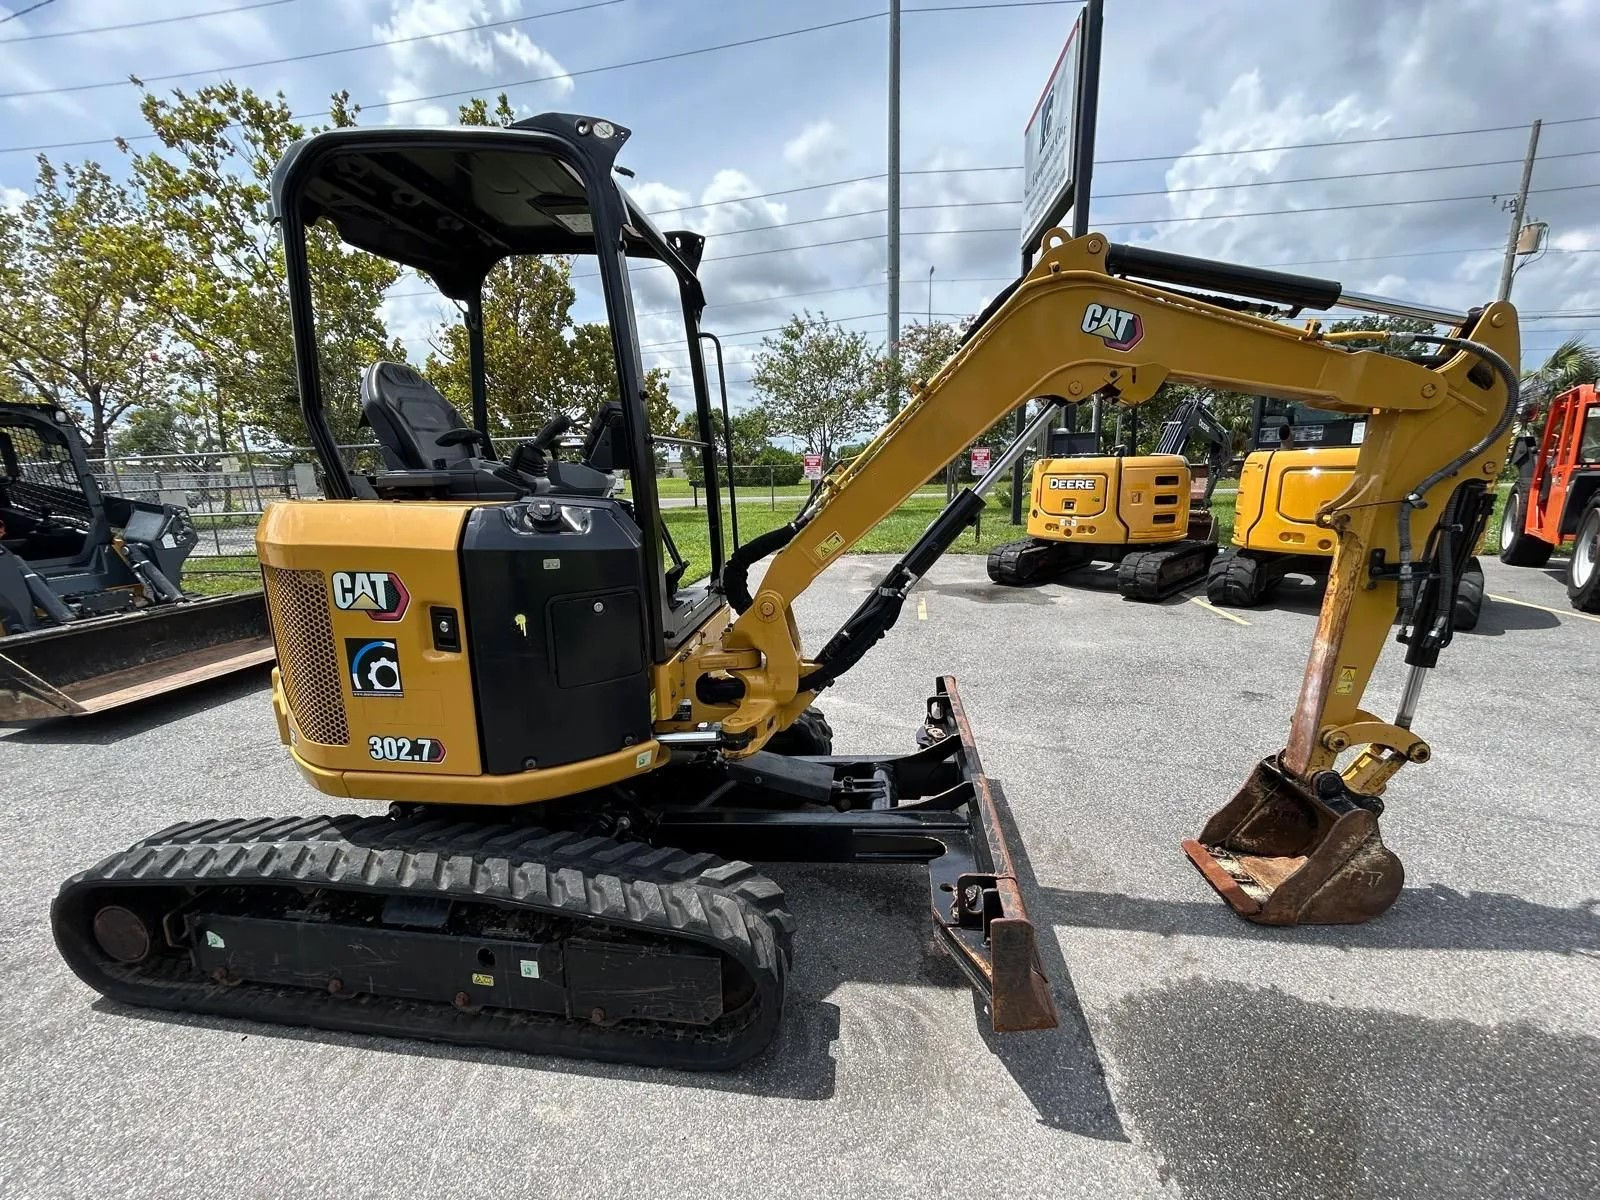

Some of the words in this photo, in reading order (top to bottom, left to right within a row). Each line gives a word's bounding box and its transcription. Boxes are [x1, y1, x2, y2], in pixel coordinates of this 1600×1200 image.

[1081, 303, 1134, 341] CAT
[1049, 478, 1095, 489] DEERE
[332, 572, 389, 610] CAT
[368, 736, 431, 761] 302.7
